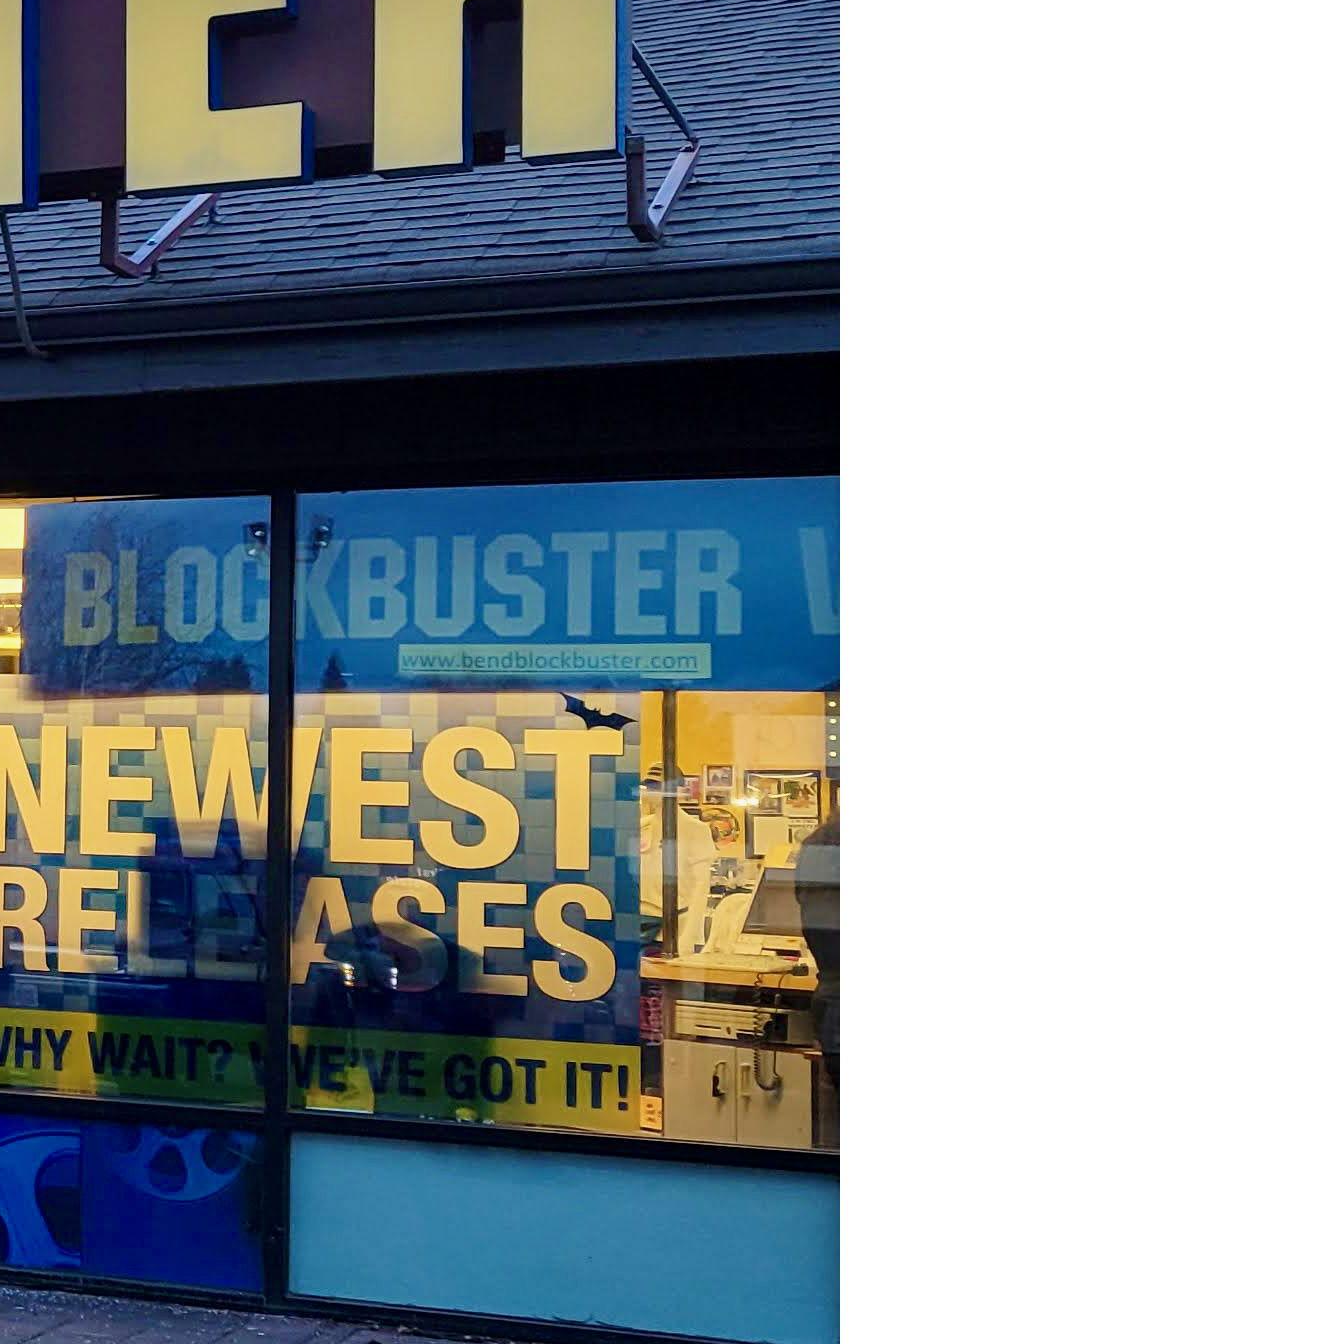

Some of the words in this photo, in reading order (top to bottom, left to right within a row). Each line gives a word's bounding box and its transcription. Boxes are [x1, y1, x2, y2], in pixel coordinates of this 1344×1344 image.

[63, 529, 742, 647] BLOCKBUSTER
[403, 650, 699, 672] www.bendblockbuster.com
[87, 1030, 234, 1084] WAIT?
[248, 1040, 427, 1098] WE'VE
[443, 1056, 548, 1106] GOT
[565, 1061, 631, 1113] IT!
